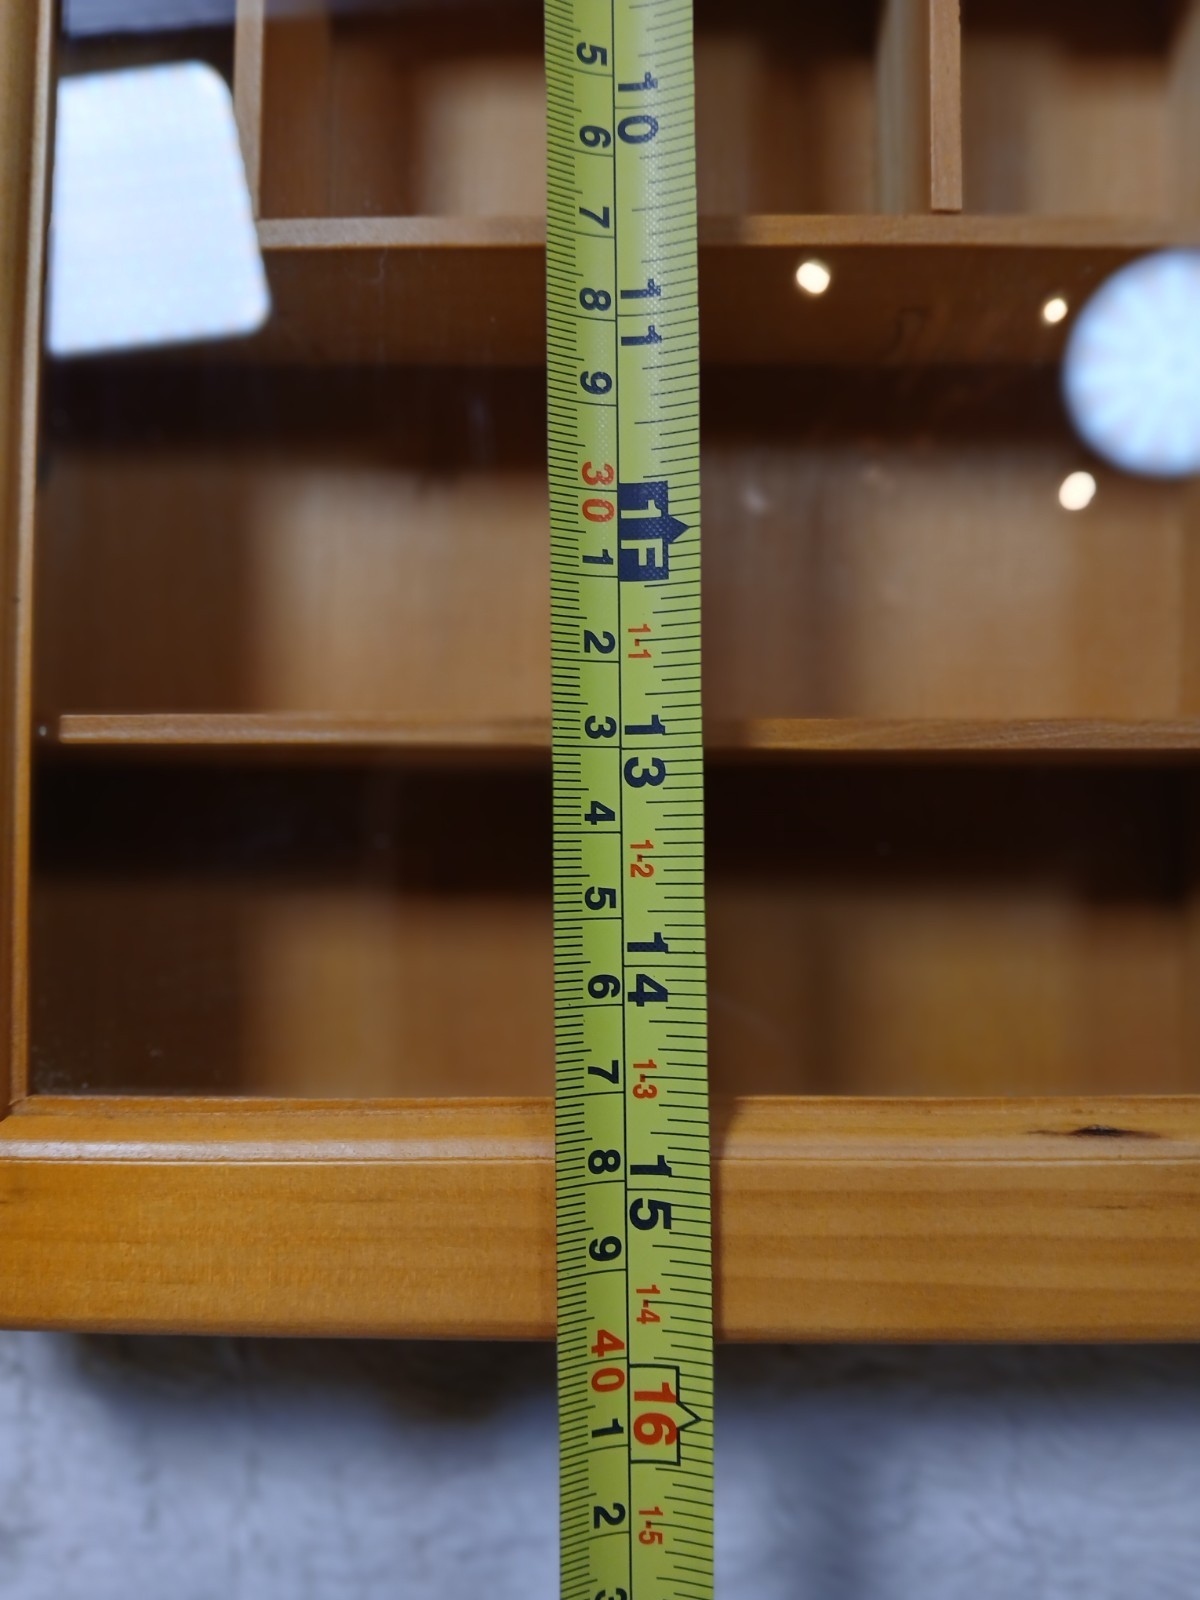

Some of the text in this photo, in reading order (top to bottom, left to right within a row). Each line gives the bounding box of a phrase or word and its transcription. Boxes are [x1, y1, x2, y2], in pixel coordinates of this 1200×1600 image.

[576, 42, 608, 66] 5
[617, 72, 659, 144] 10
[579, 125, 612, 148] 6
[579, 206, 610, 228] 7
[579, 287, 612, 311] 8
[620, 278, 662, 346] 11
[580, 371, 613, 395] 9
[581, 461, 615, 523] 30
[620, 499, 663, 568] 1F
[582, 549, 614, 565] 1
[583, 630, 616, 654] 2
[584, 715, 617, 739] 3
[624, 714, 667, 788] 13
[584, 801, 616, 825] 4
[584, 886, 617, 910] 5
[627, 932, 669, 1007] 14
[587, 974, 621, 999] 6
[588, 1060, 619, 1084] 7
[588, 1149, 621, 1174] 8
[629, 1155, 672, 1231] 15
[589, 1236, 622, 1261] 9
[591, 1329, 625, 1392] 40
[633, 1382, 678, 1446] 16
[591, 1418, 624, 1438] 1
[593, 1502, 626, 1529] 2
